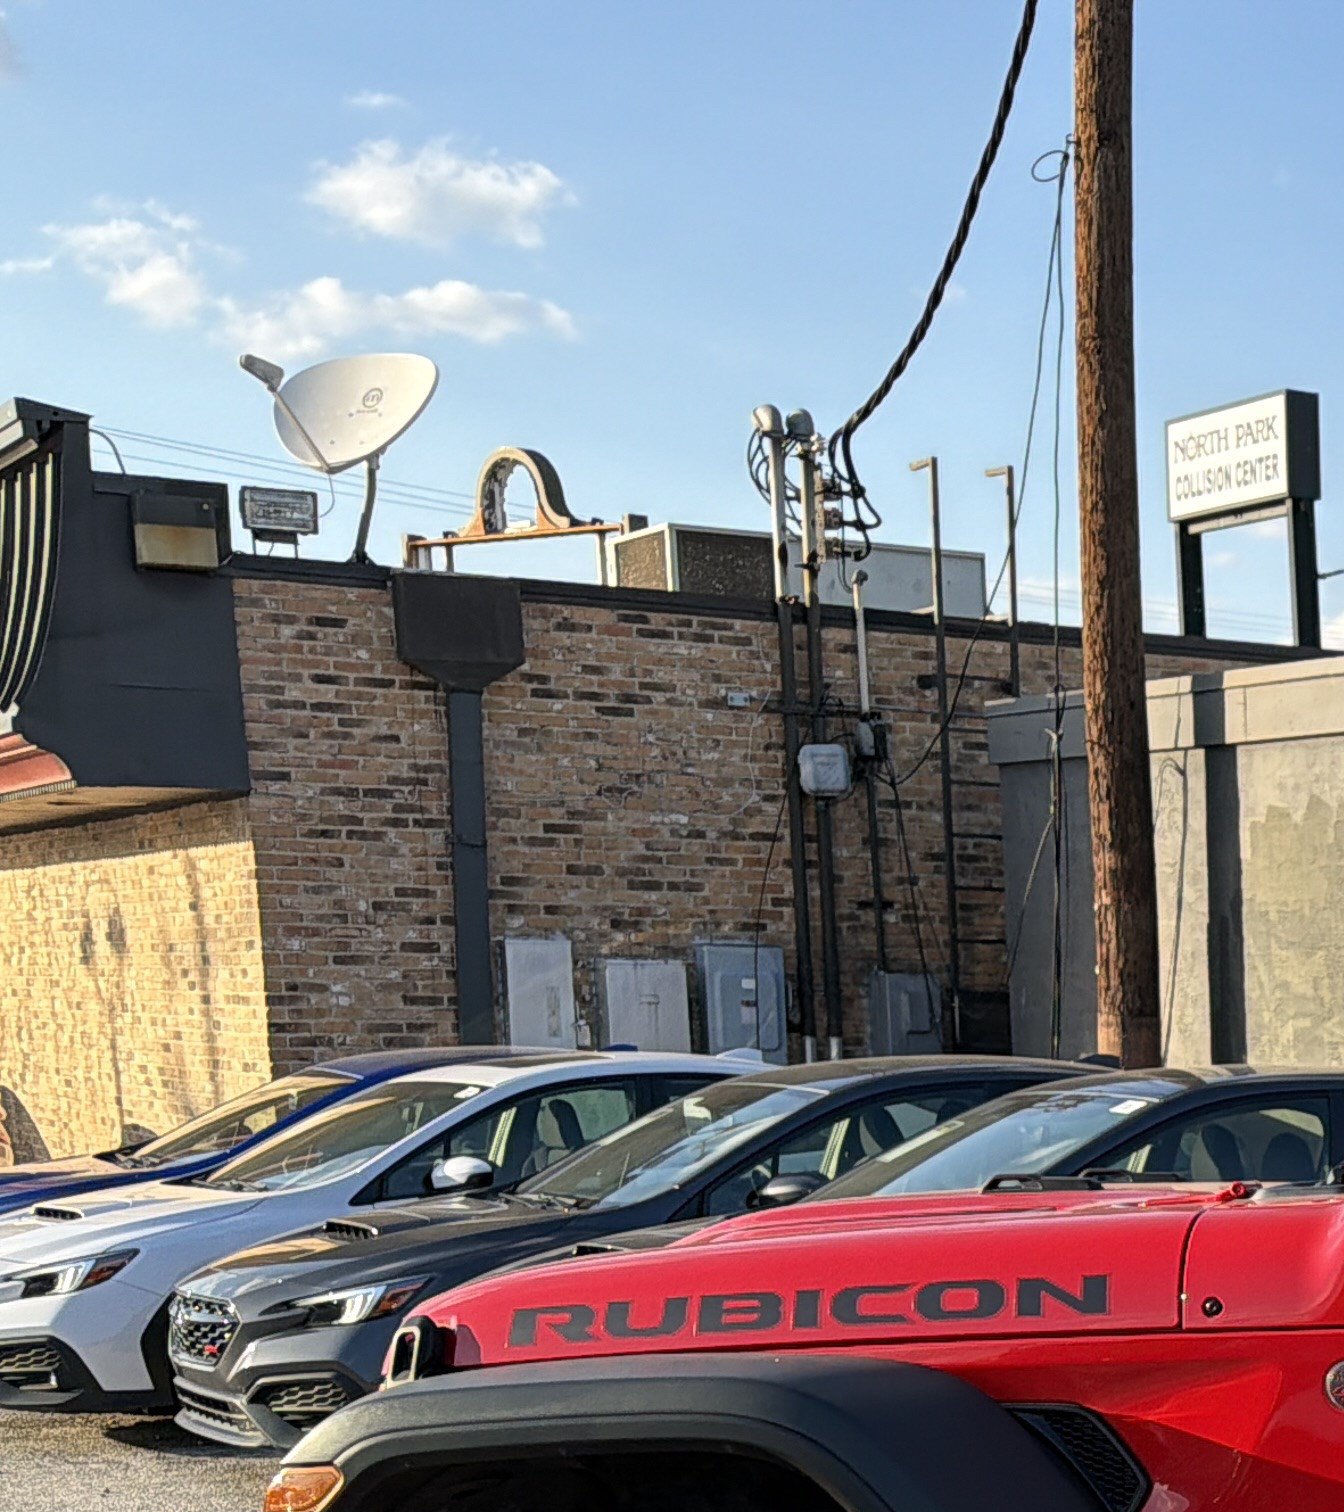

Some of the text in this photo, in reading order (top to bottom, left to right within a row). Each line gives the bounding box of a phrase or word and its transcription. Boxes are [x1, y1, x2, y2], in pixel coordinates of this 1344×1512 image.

[1173, 414, 1280, 464] NORTH PARK
[1175, 453, 1280, 501] COLLISION CENTER
[507, 1273, 1110, 1348] RUBICON
